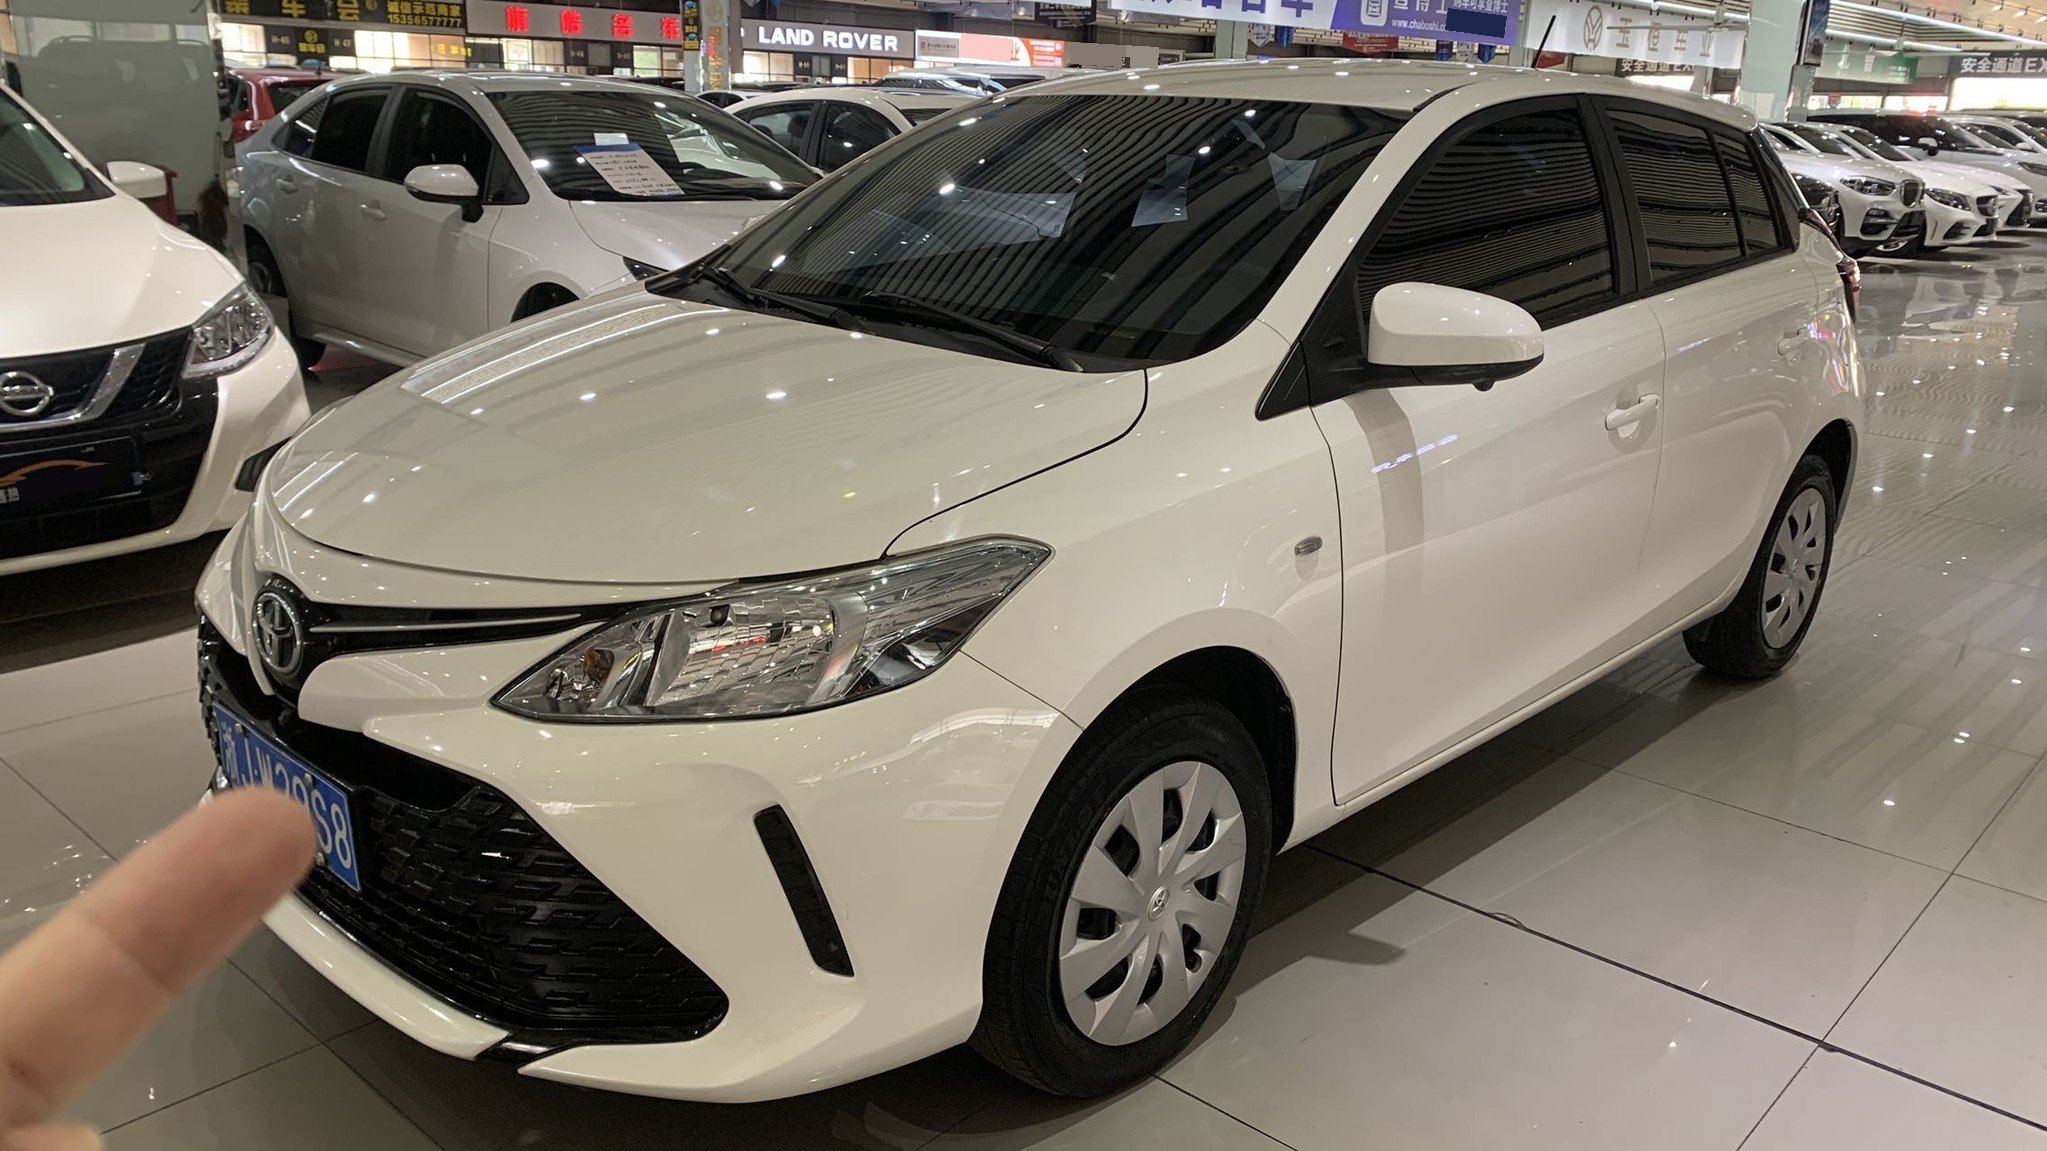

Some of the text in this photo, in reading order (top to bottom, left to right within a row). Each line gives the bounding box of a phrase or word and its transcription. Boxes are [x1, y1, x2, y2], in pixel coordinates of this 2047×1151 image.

[387, 14, 460, 28] 15356577777
[758, 26, 898, 51] LAND ROVER
